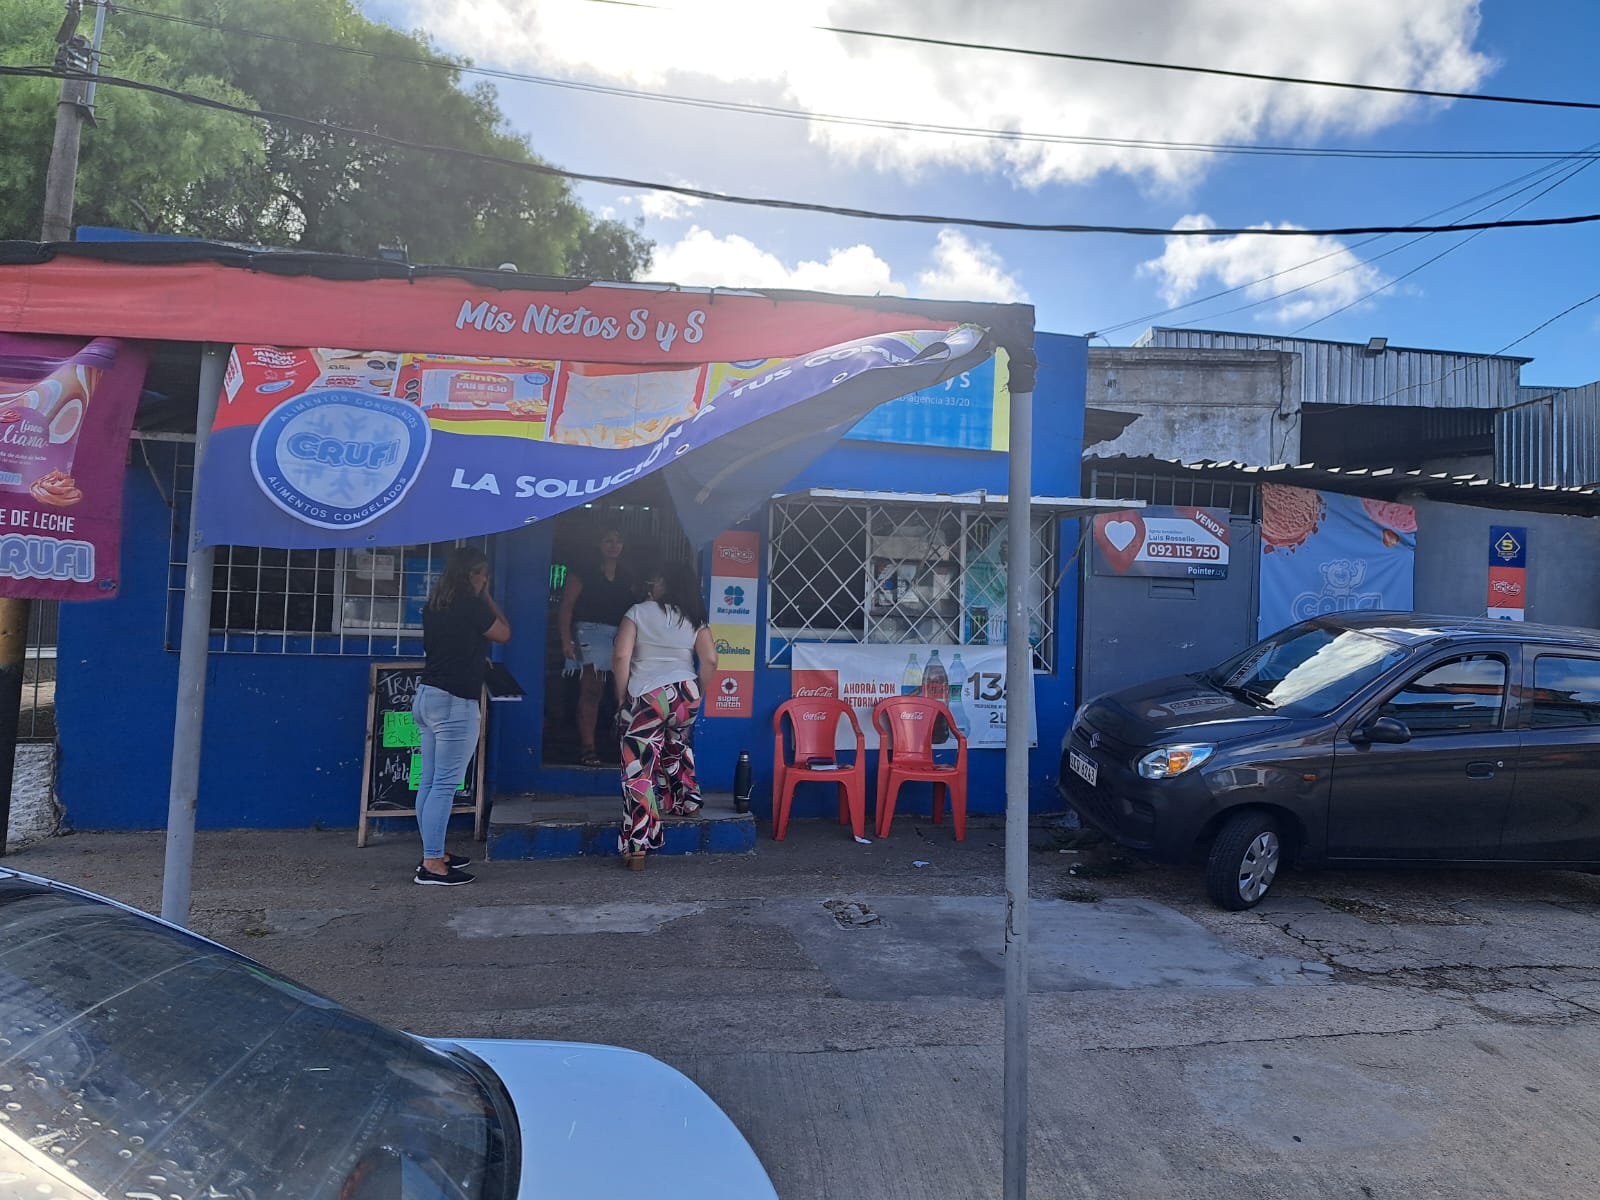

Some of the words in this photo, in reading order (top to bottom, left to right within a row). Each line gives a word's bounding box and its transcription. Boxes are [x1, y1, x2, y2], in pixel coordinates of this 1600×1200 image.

[456, 300, 516, 334] Mis
[522, 304, 620, 339] Nietos
[627, 308, 649, 340] S
[656, 321, 677, 352] y
[684, 310, 706, 343] S
[945, 396, 970, 407] 33/20
[450, 469, 501, 495] LA
[728, 366, 793, 399] TUS
[803, 344, 909, 367] COM
[267, 475, 328, 518] ALIMENTOS
[333, 476, 407, 522] CONGELADOS
[11, 509, 30, 527] DE
[33, 511, 75, 533] LECHE
[1195, 510, 1225, 537] VENDE
[0, 535, 93, 581] RUFI
[1149, 544, 1172, 556] 092
[1175, 545, 1192, 557] 115
[1196, 546, 1218, 559] 750
[879, 683, 896, 694] CON
